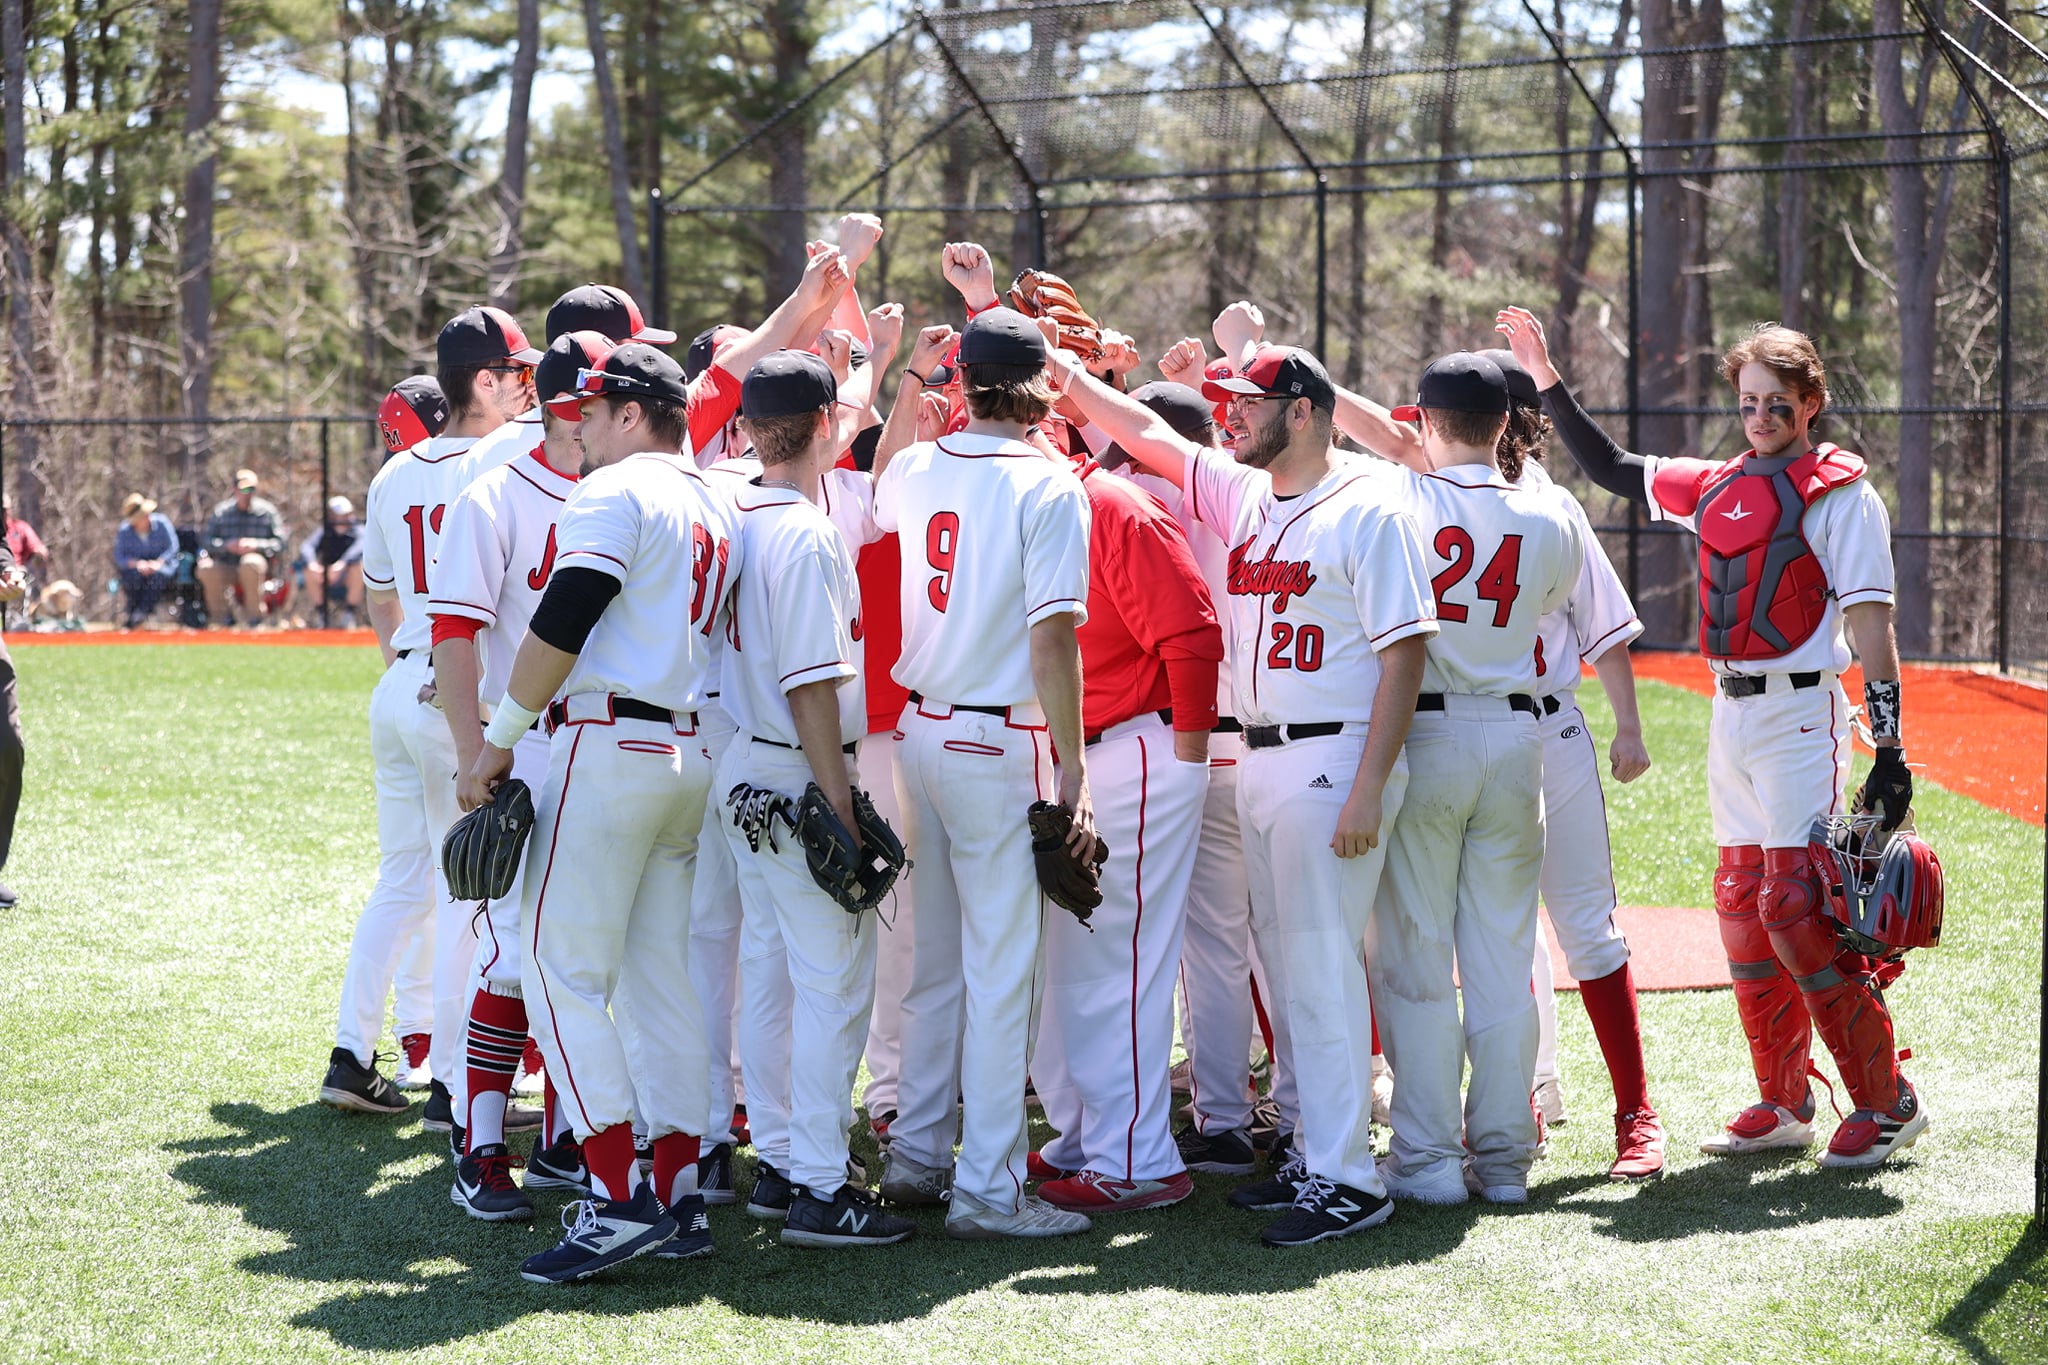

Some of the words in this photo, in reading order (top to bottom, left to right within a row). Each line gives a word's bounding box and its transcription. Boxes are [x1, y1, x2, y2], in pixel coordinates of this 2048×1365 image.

[926, 511, 960, 614] 9
[1430, 525, 1524, 628] 24
[1268, 622, 1324, 672] 20
[481, 1147, 497, 1157] NIKE
[836, 1207, 870, 1234] N
[1325, 1196, 1362, 1223] N
